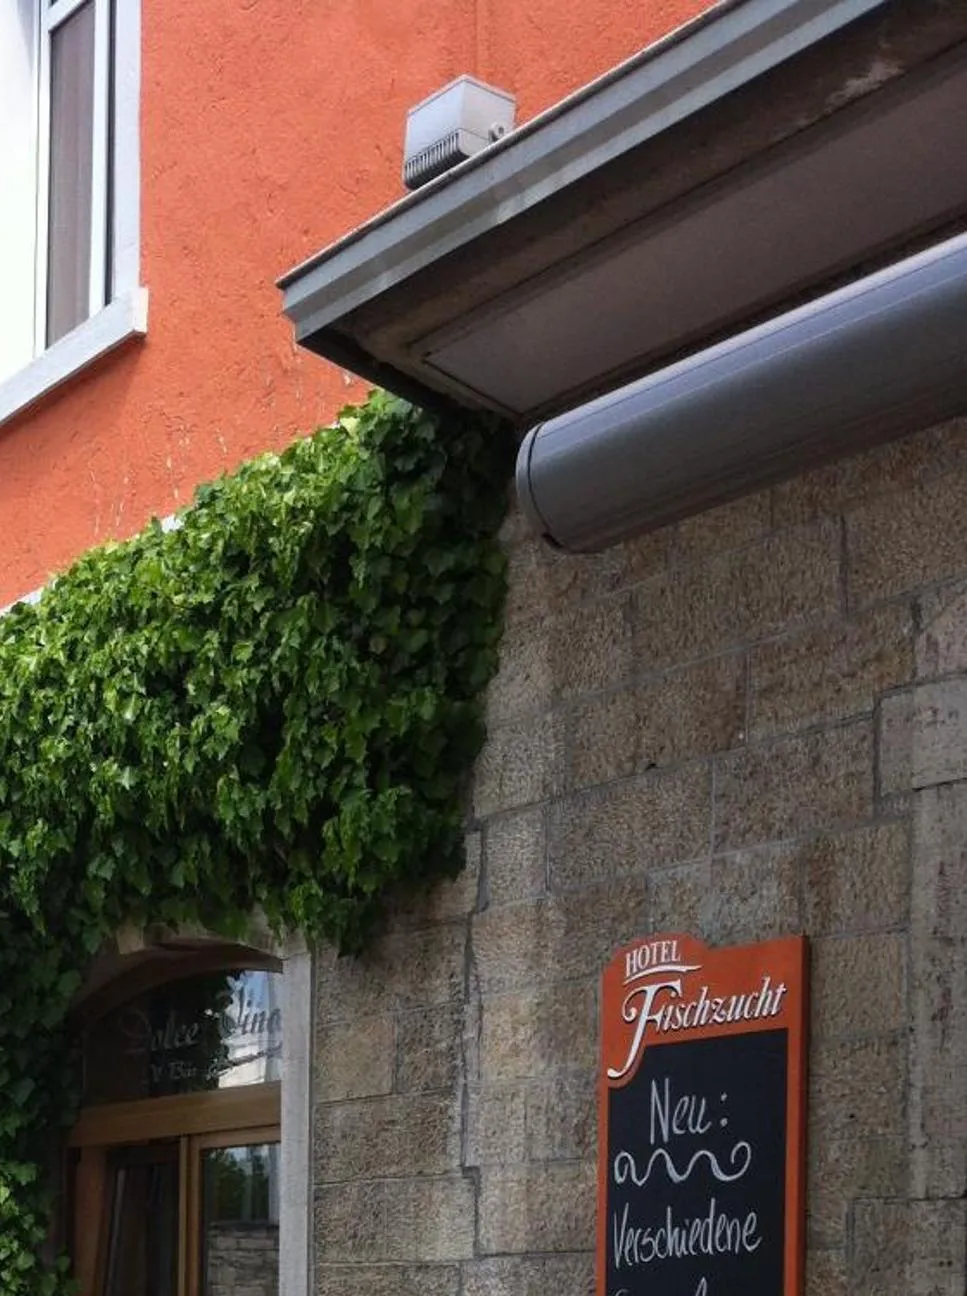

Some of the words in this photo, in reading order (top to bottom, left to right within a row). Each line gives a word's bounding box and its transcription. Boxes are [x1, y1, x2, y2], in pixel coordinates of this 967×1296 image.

[625, 940, 682, 978] HOTEL
[607, 976, 787, 1078] Fischzucht
[613, 1197, 762, 1269] Verschiedene
